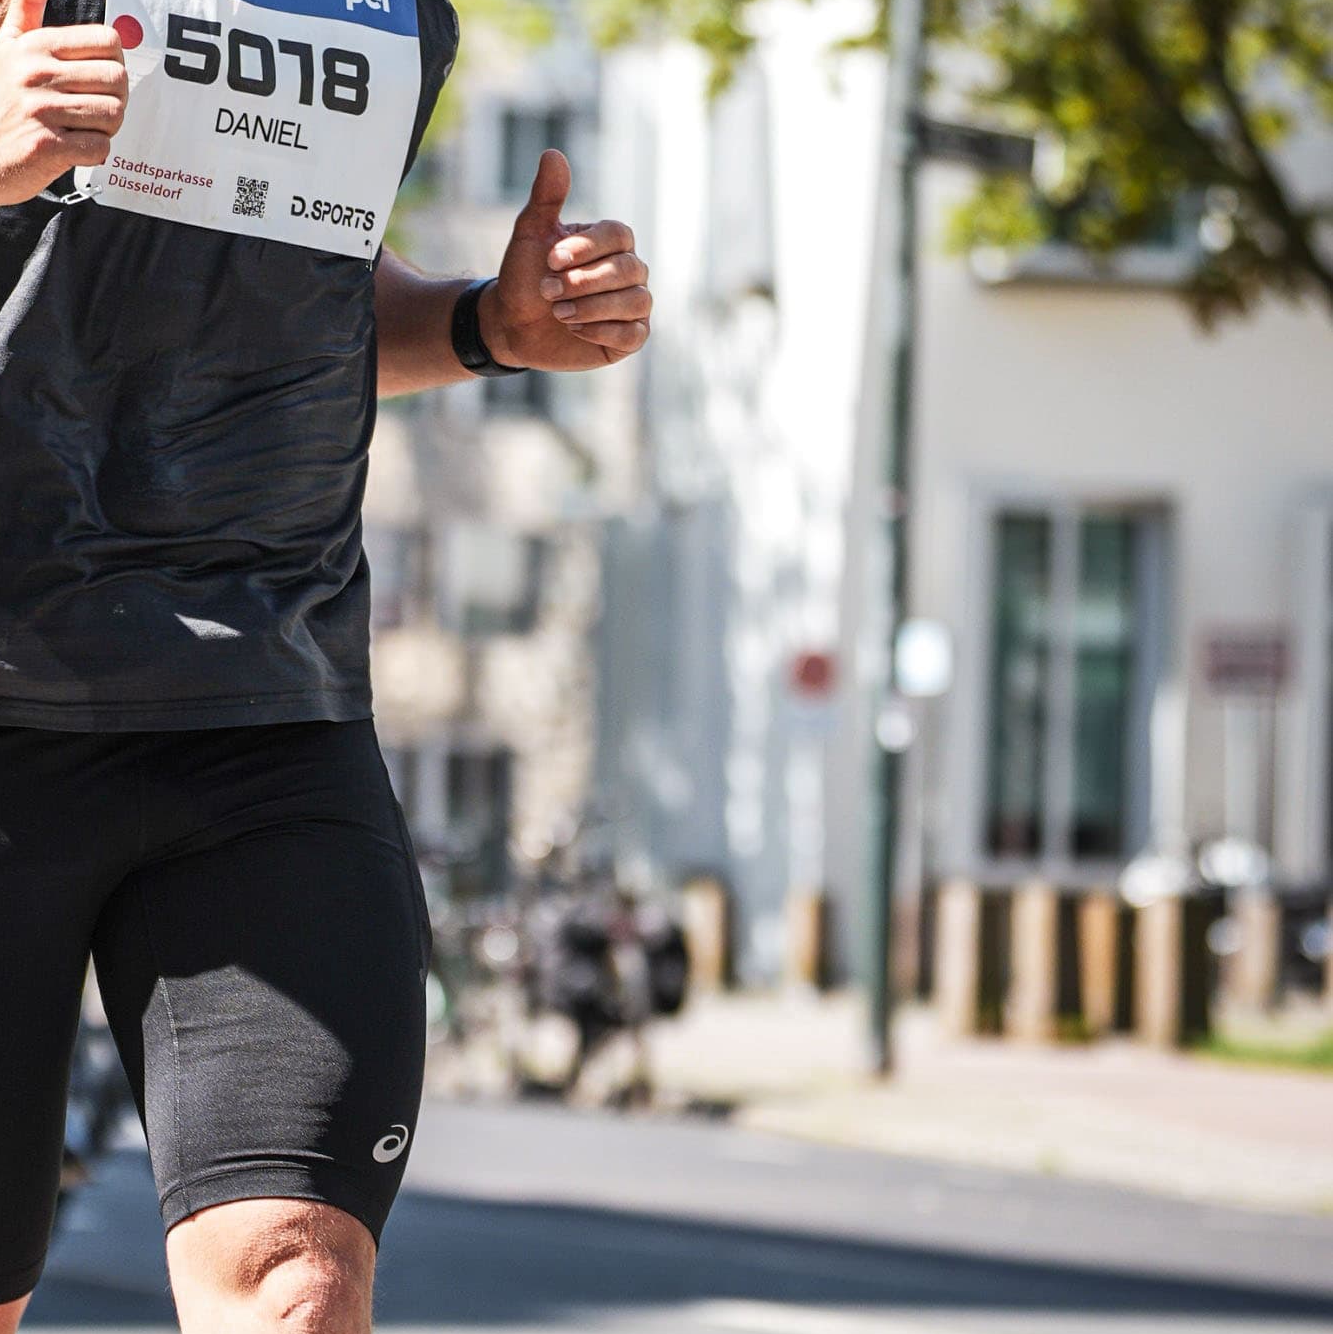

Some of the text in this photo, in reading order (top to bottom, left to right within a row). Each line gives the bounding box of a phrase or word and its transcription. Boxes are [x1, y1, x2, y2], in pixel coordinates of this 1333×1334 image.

[215, 108, 309, 150] DANIEL
[108, 173, 183, 200] Düsseldorf
[112, 156, 213, 188] Stadtsparkasse
[290, 195, 375, 231] D.SPORTS
